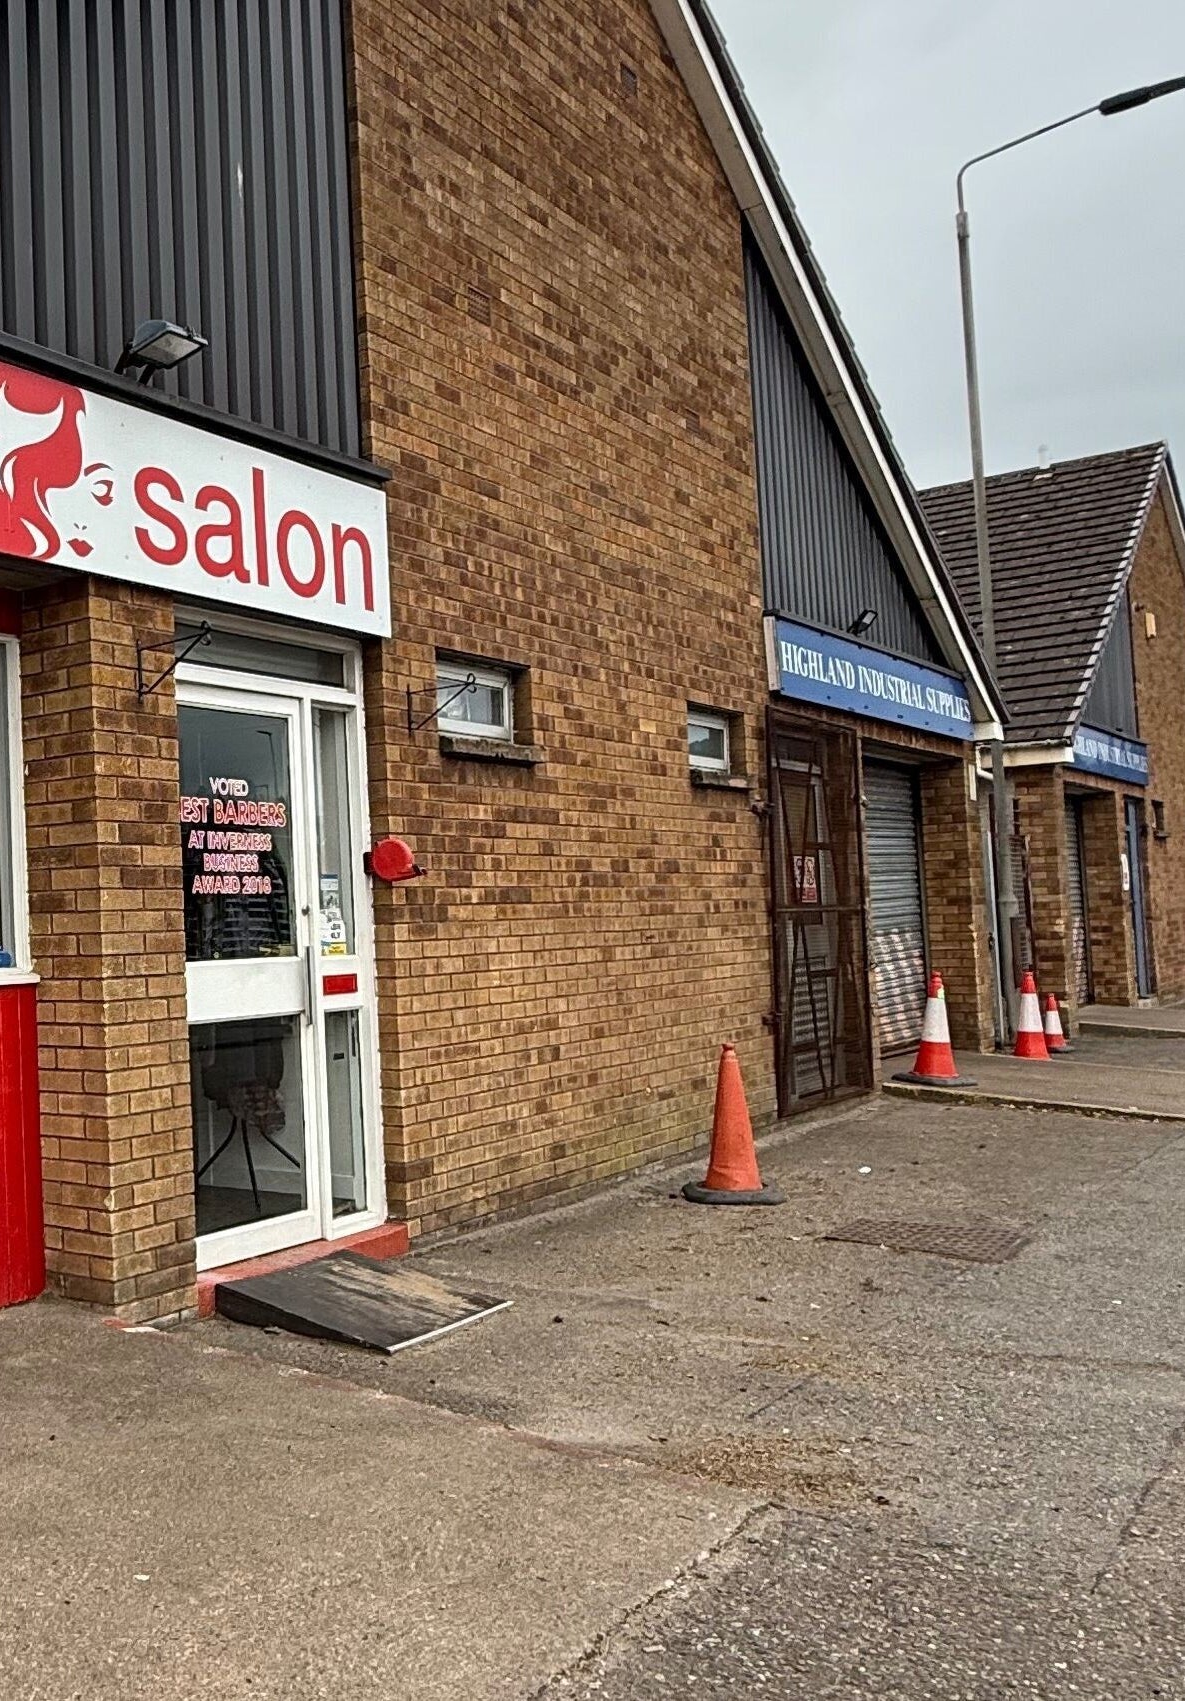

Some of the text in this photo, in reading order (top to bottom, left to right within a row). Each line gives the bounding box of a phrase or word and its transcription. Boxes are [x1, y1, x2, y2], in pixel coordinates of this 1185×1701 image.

[134, 466, 375, 612] salon
[780, 641, 972, 723] HIGHLAND INDUSTRIAL SUPPLIES
[208, 776, 249, 797] VOTED
[179, 796, 286, 828] EST BARBERS
[188, 829, 272, 852] AT INVERNESS
[203, 853, 259, 873] BUSINESS
[192, 875, 240, 895] AWARD
